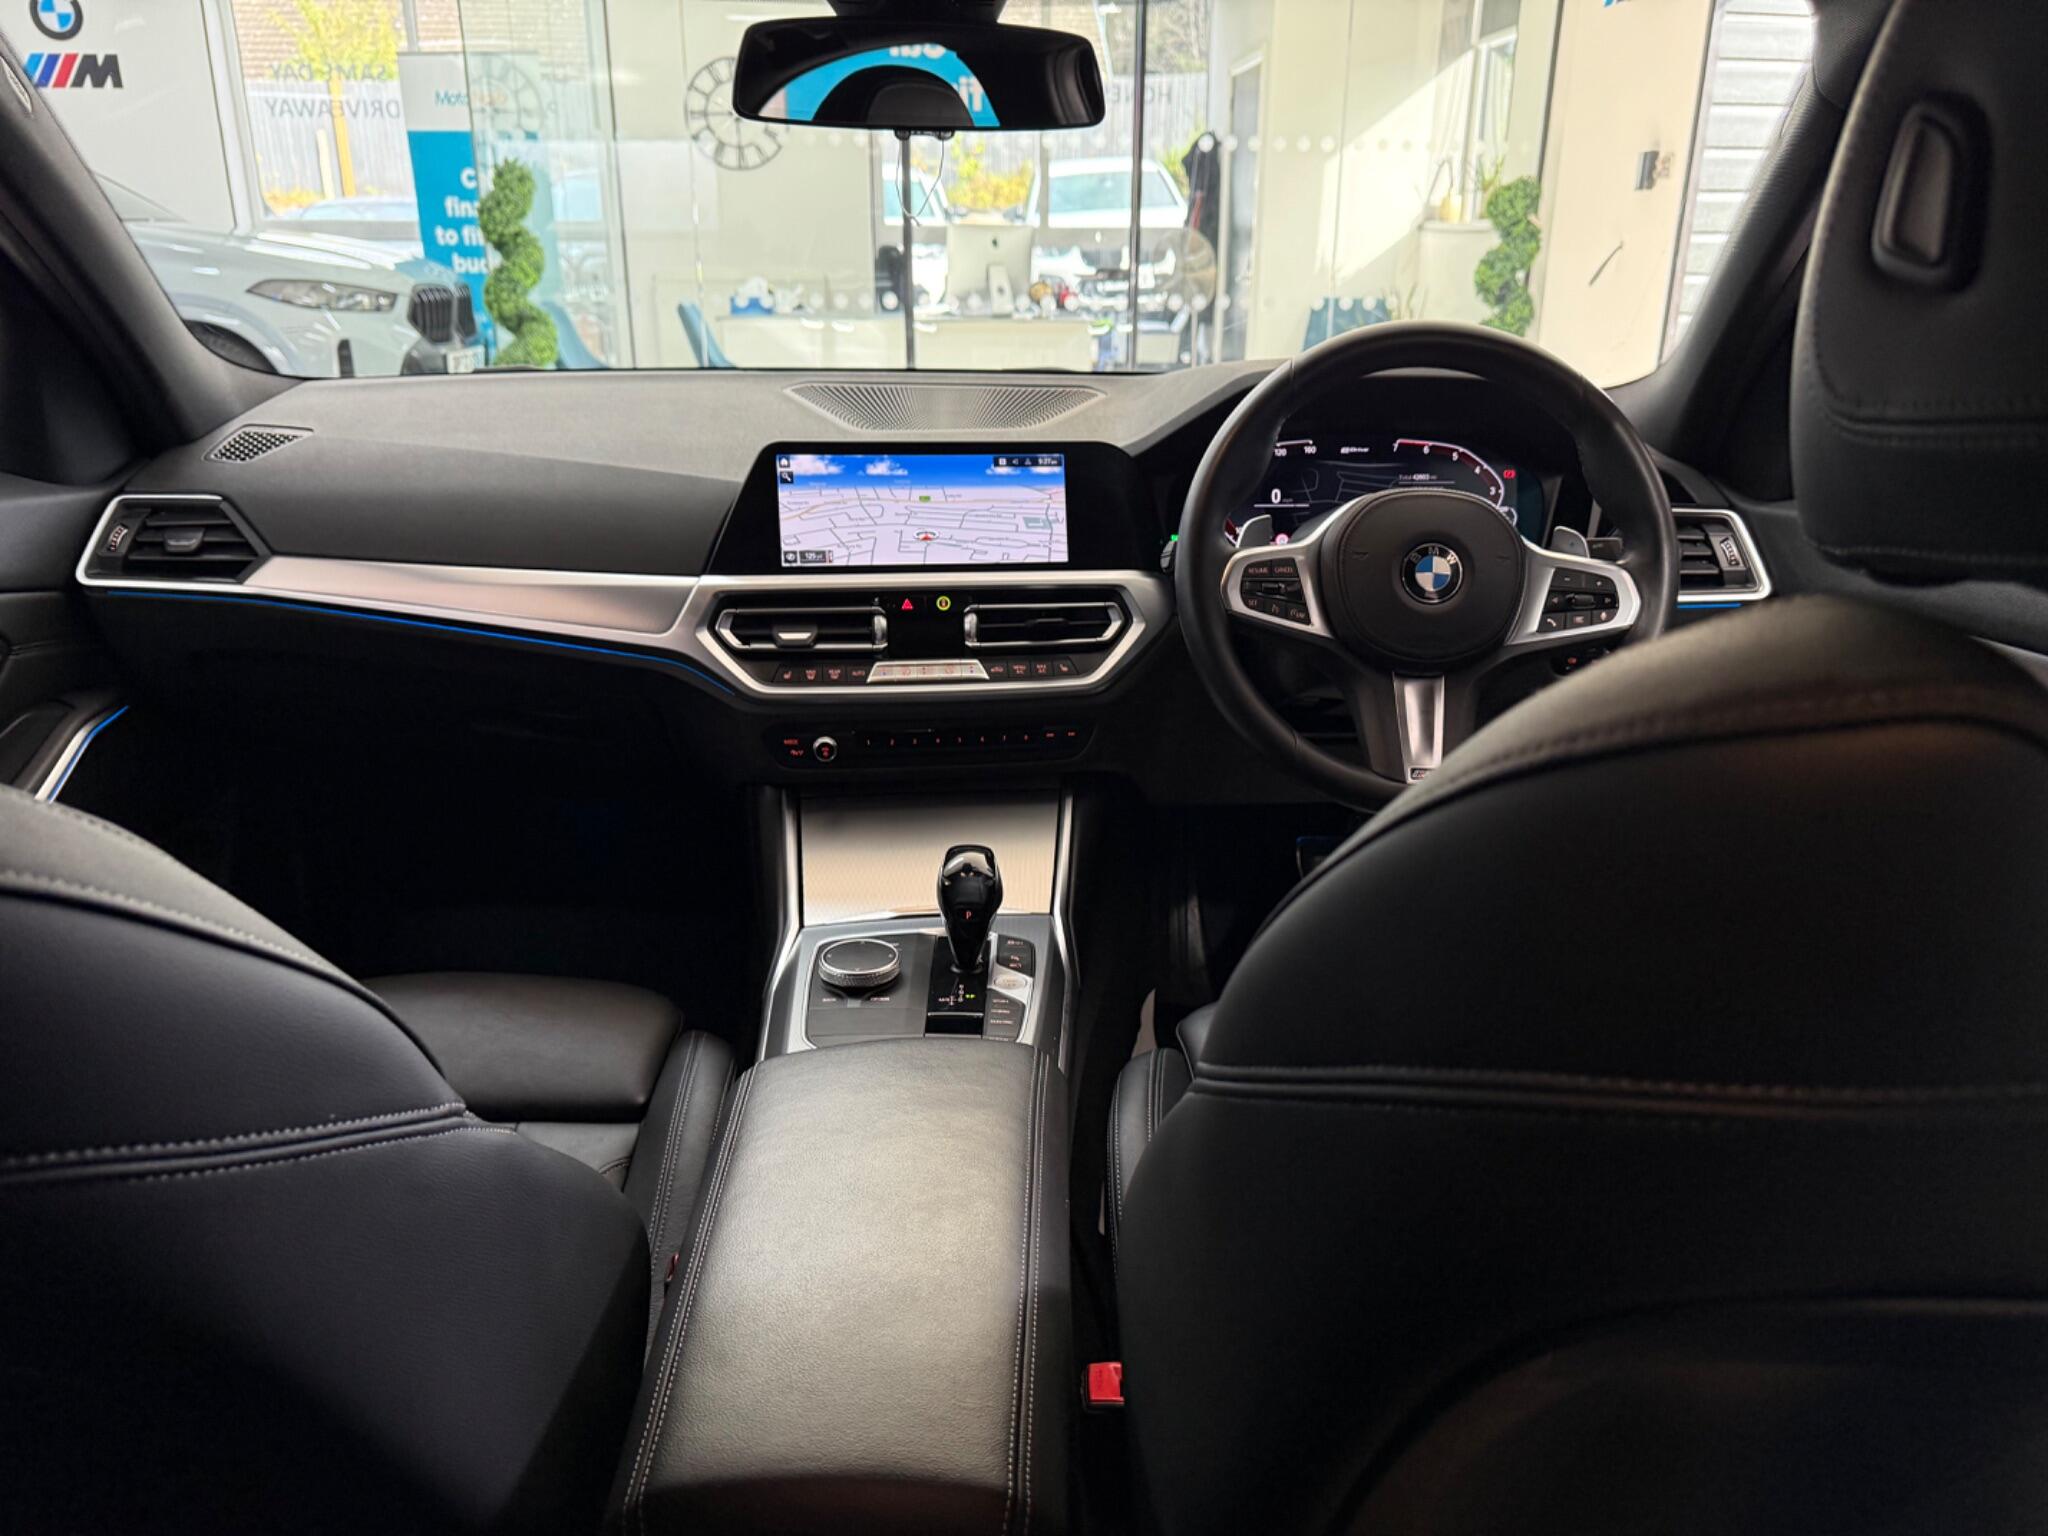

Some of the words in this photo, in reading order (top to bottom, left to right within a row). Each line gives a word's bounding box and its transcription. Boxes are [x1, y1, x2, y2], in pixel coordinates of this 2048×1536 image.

[435, 224, 459, 246] to
[1271, 488, 1281, 504] 0
[965, 910, 972, 920] P
